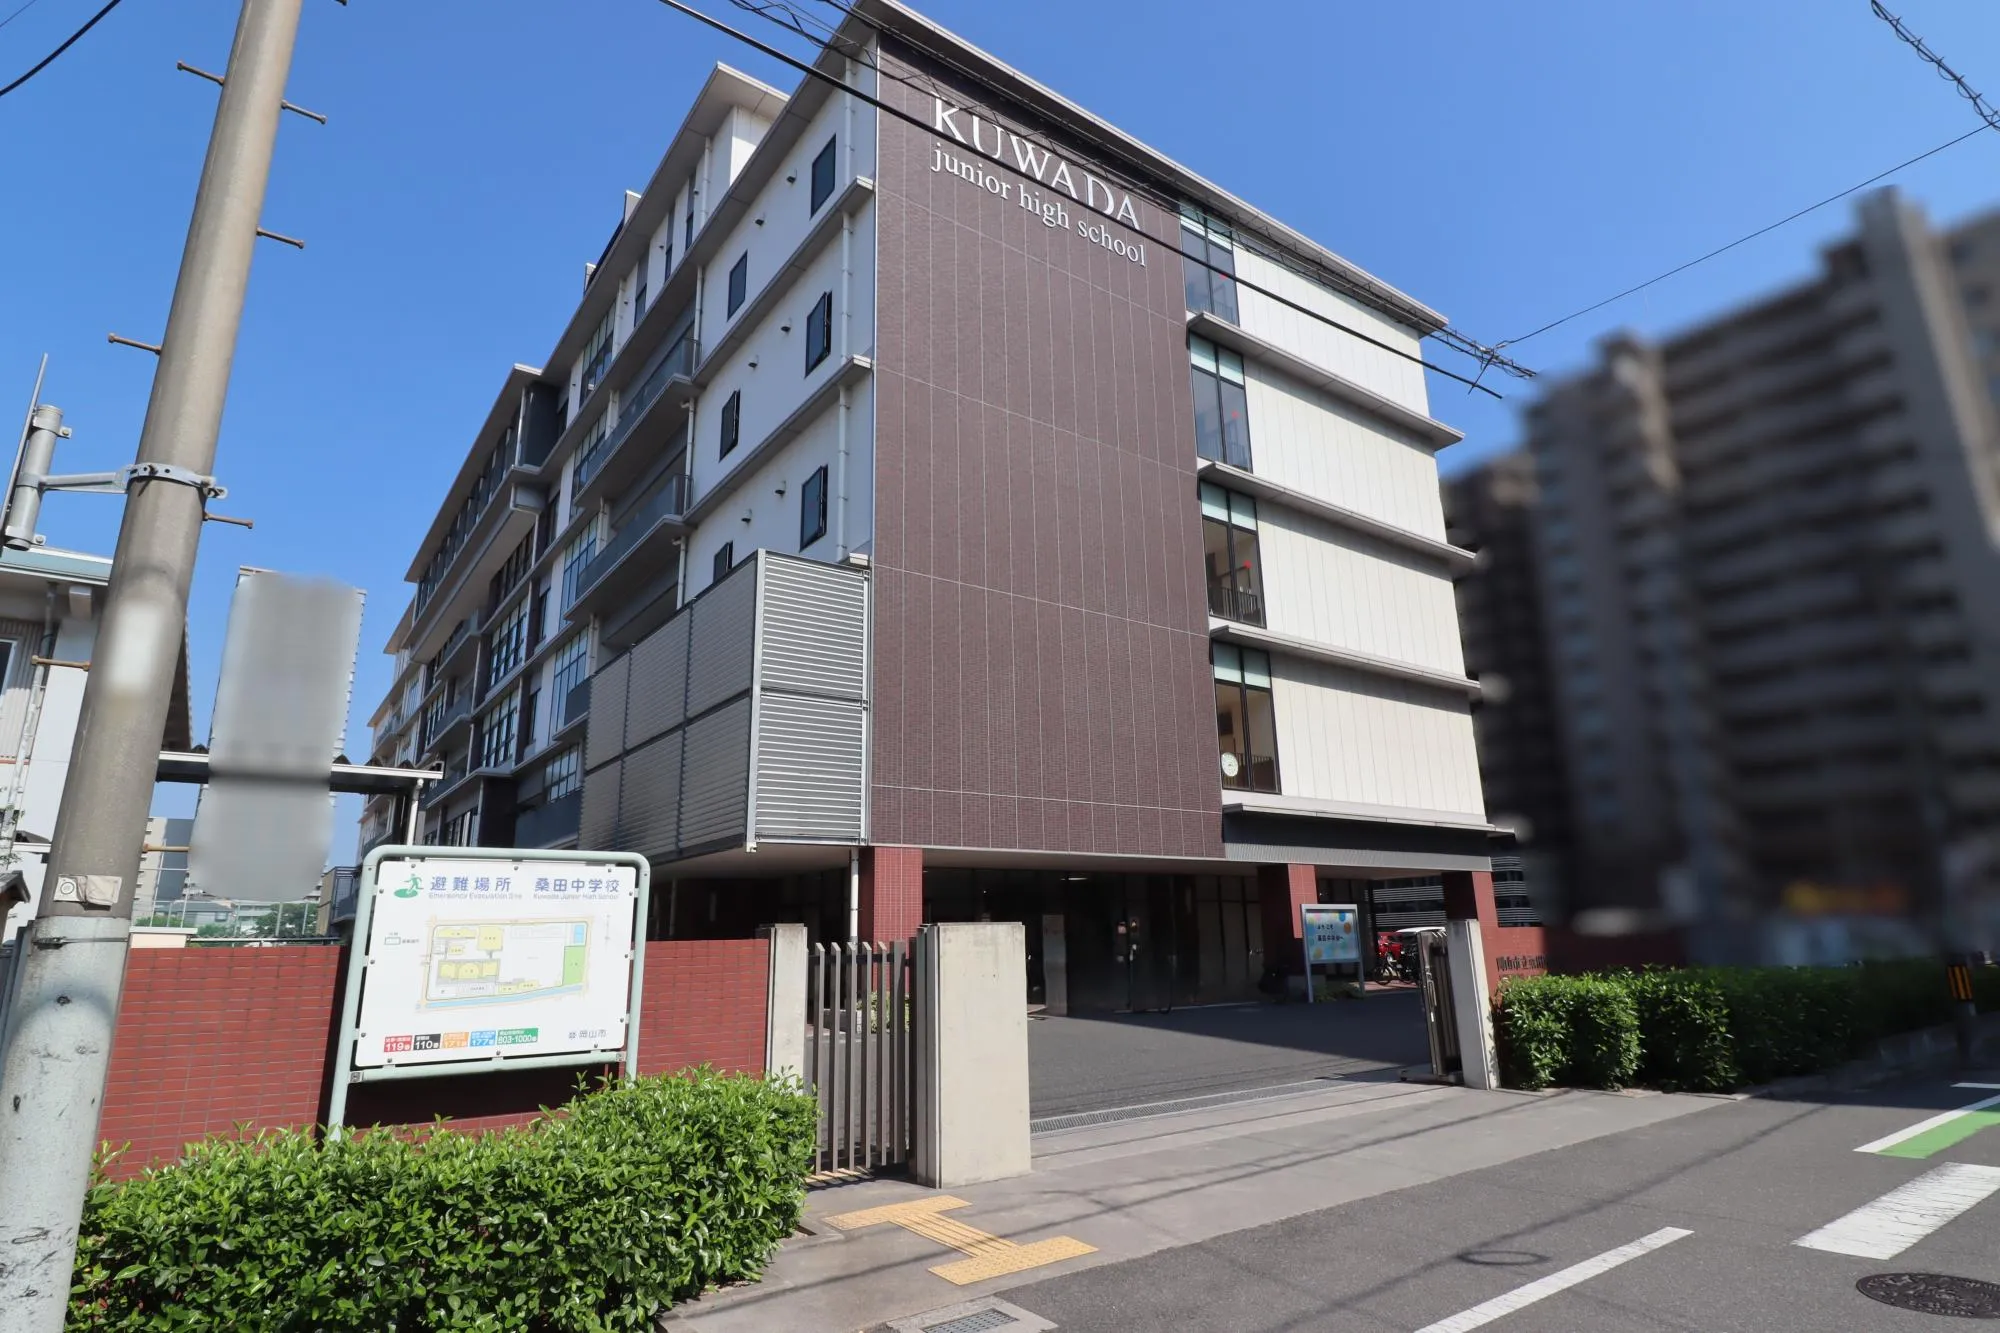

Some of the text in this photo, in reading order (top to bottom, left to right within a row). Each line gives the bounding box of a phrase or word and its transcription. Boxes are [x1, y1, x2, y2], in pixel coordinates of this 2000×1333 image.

[931, 90, 1141, 230] KUWADA
[931, 142, 1148, 268] junior high school
[430, 876, 620, 893] 避難場所 桑田中学校
